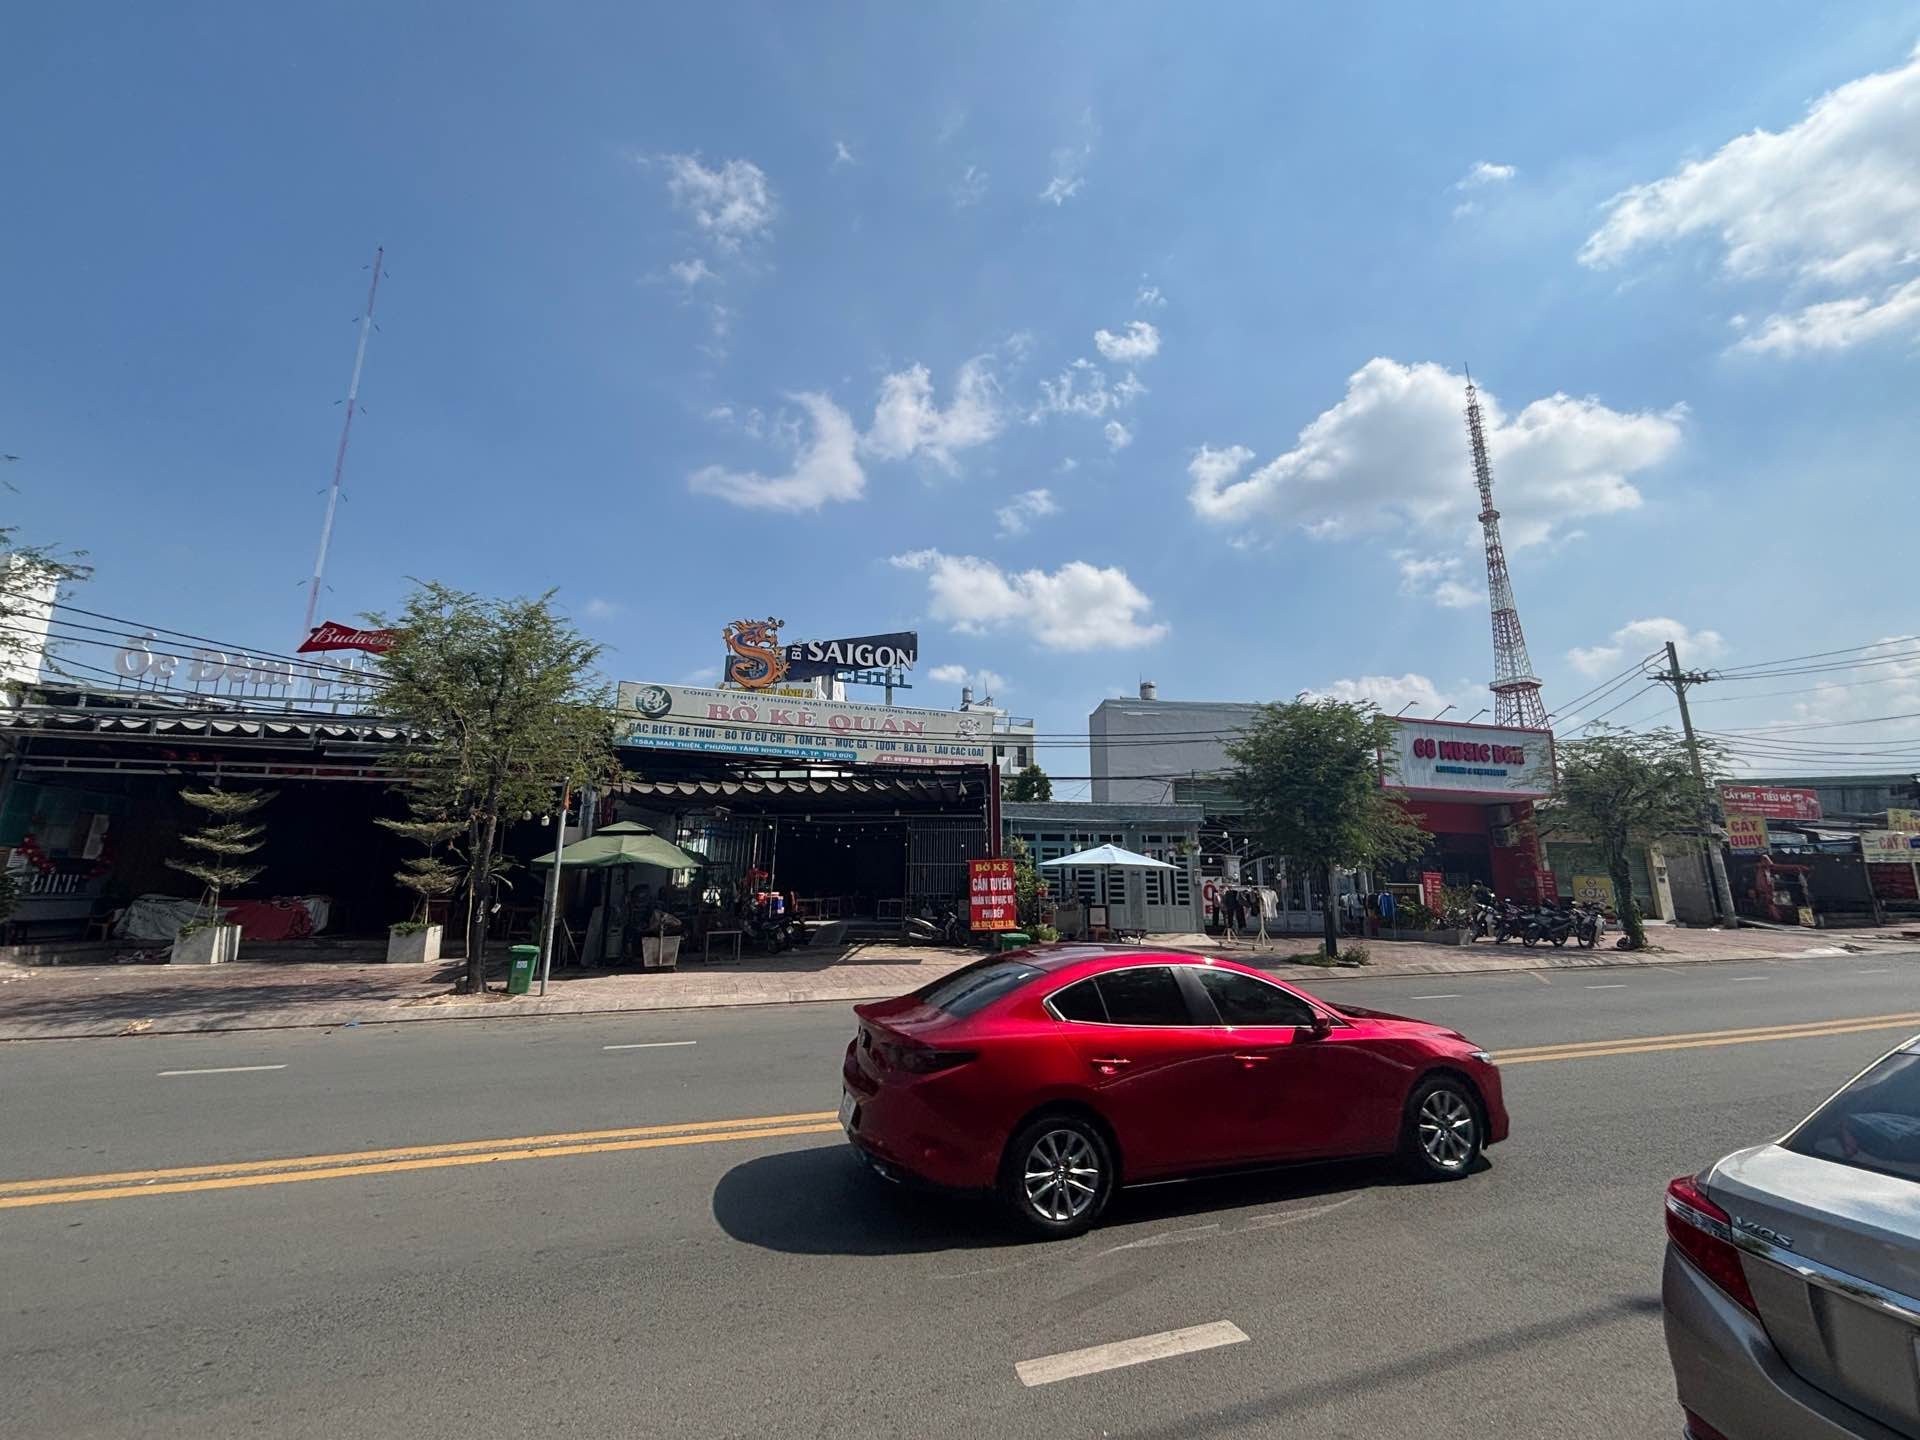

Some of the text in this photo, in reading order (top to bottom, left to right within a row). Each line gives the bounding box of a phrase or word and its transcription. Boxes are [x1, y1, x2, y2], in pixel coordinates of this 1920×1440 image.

[791, 638, 802, 661] BIA
[807, 639, 914, 671] SAIGON
[835, 668, 912, 689] CHILL
[731, 694, 758, 702] TNHH
[769, 706, 817, 729] KÈ
[827, 713, 926, 738] QUÁN
[693, 727, 716, 739] THUI
[769, 732, 785, 743] CHI
[1438, 740, 1491, 763] MUSIC
[1729, 834, 1763, 847] QUAY
[1735, 1216, 1794, 1248] VIOS
